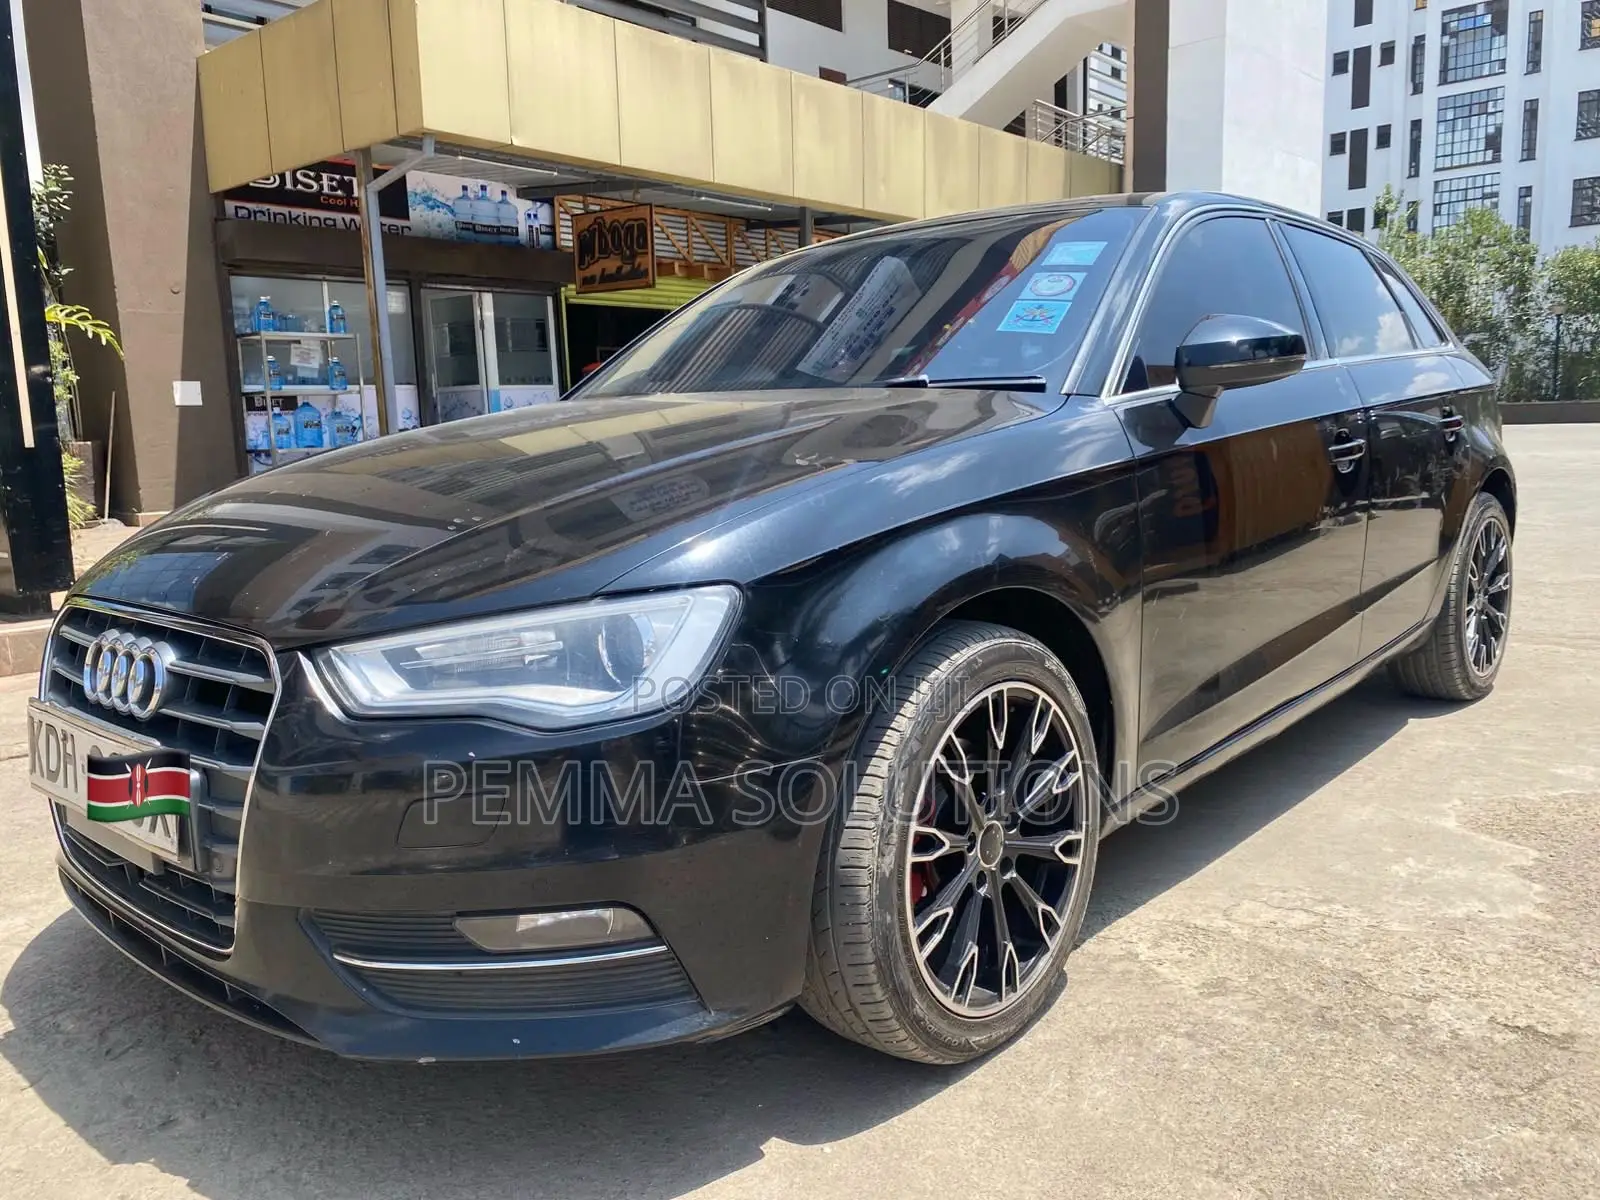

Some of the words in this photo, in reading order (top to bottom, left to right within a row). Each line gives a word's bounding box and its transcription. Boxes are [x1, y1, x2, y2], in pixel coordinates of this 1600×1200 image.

[320, 195, 347, 206] Cool
[234, 205, 336, 229] Drinking
[342, 216, 412, 238] Wter
[29, 715, 79, 794] KDH
